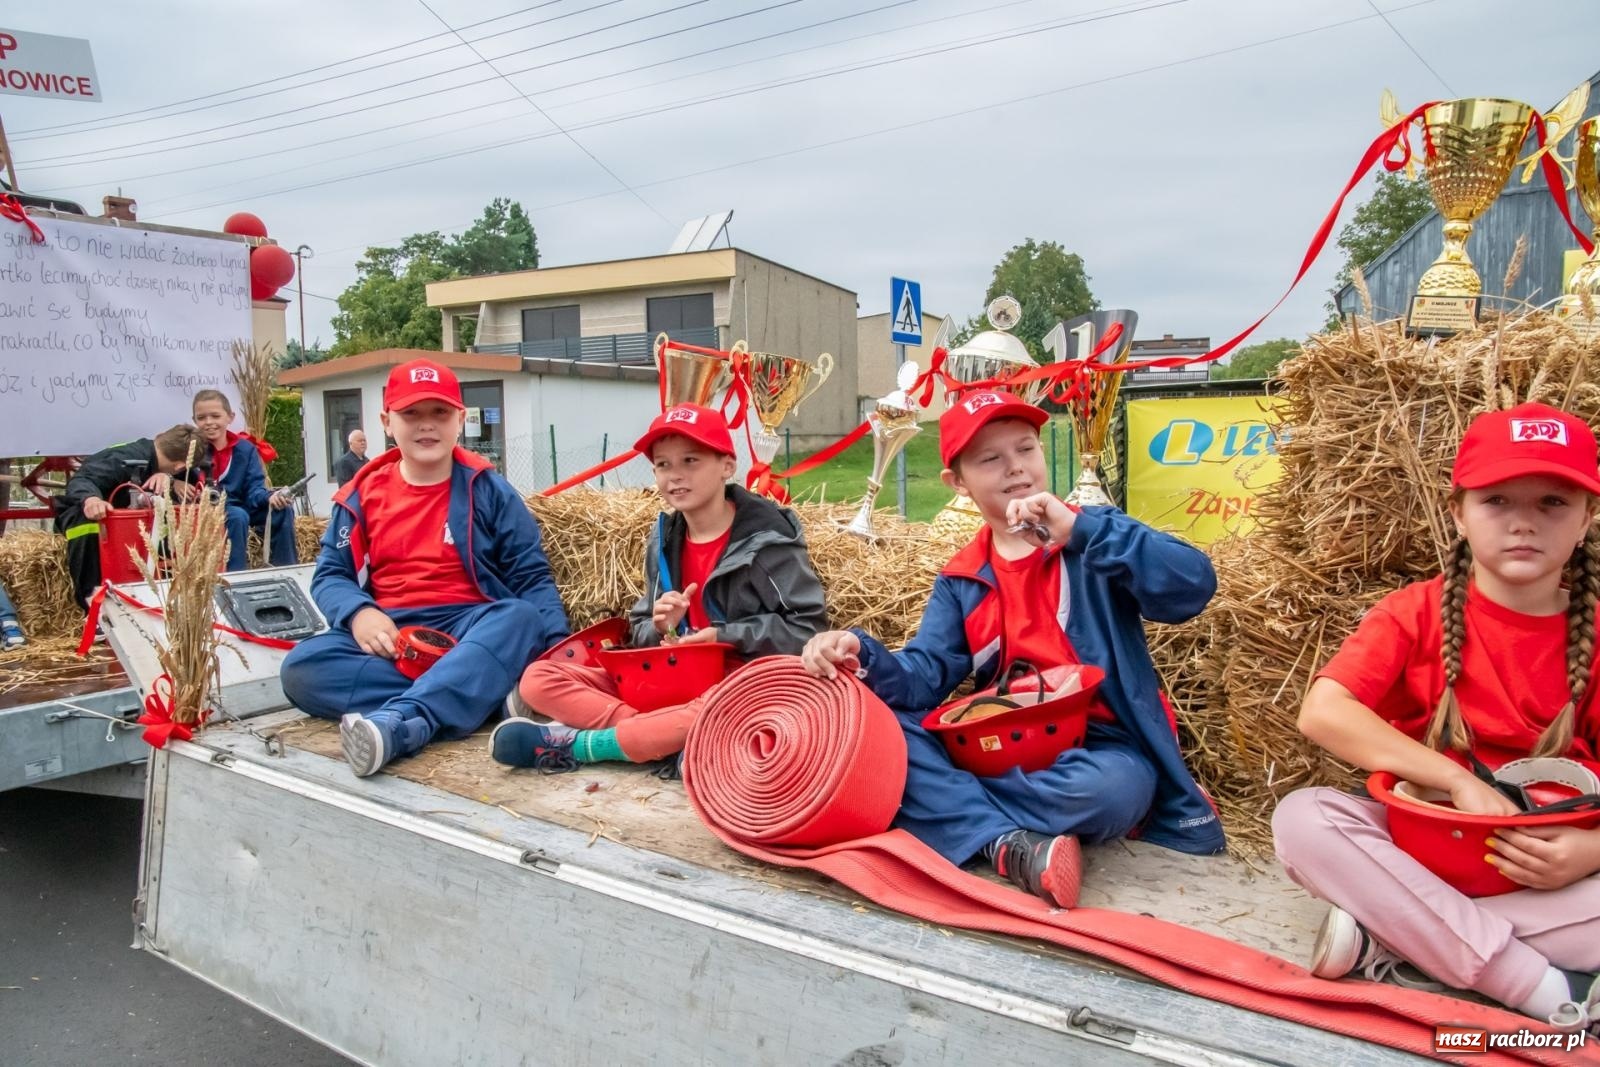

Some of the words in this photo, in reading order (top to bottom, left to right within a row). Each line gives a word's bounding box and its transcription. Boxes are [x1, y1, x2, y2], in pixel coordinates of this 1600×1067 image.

[55, 228, 81, 252] to
[87, 234, 113, 260] nie
[124, 334, 149, 363] my
[1186, 489, 1256, 523] Zapr
